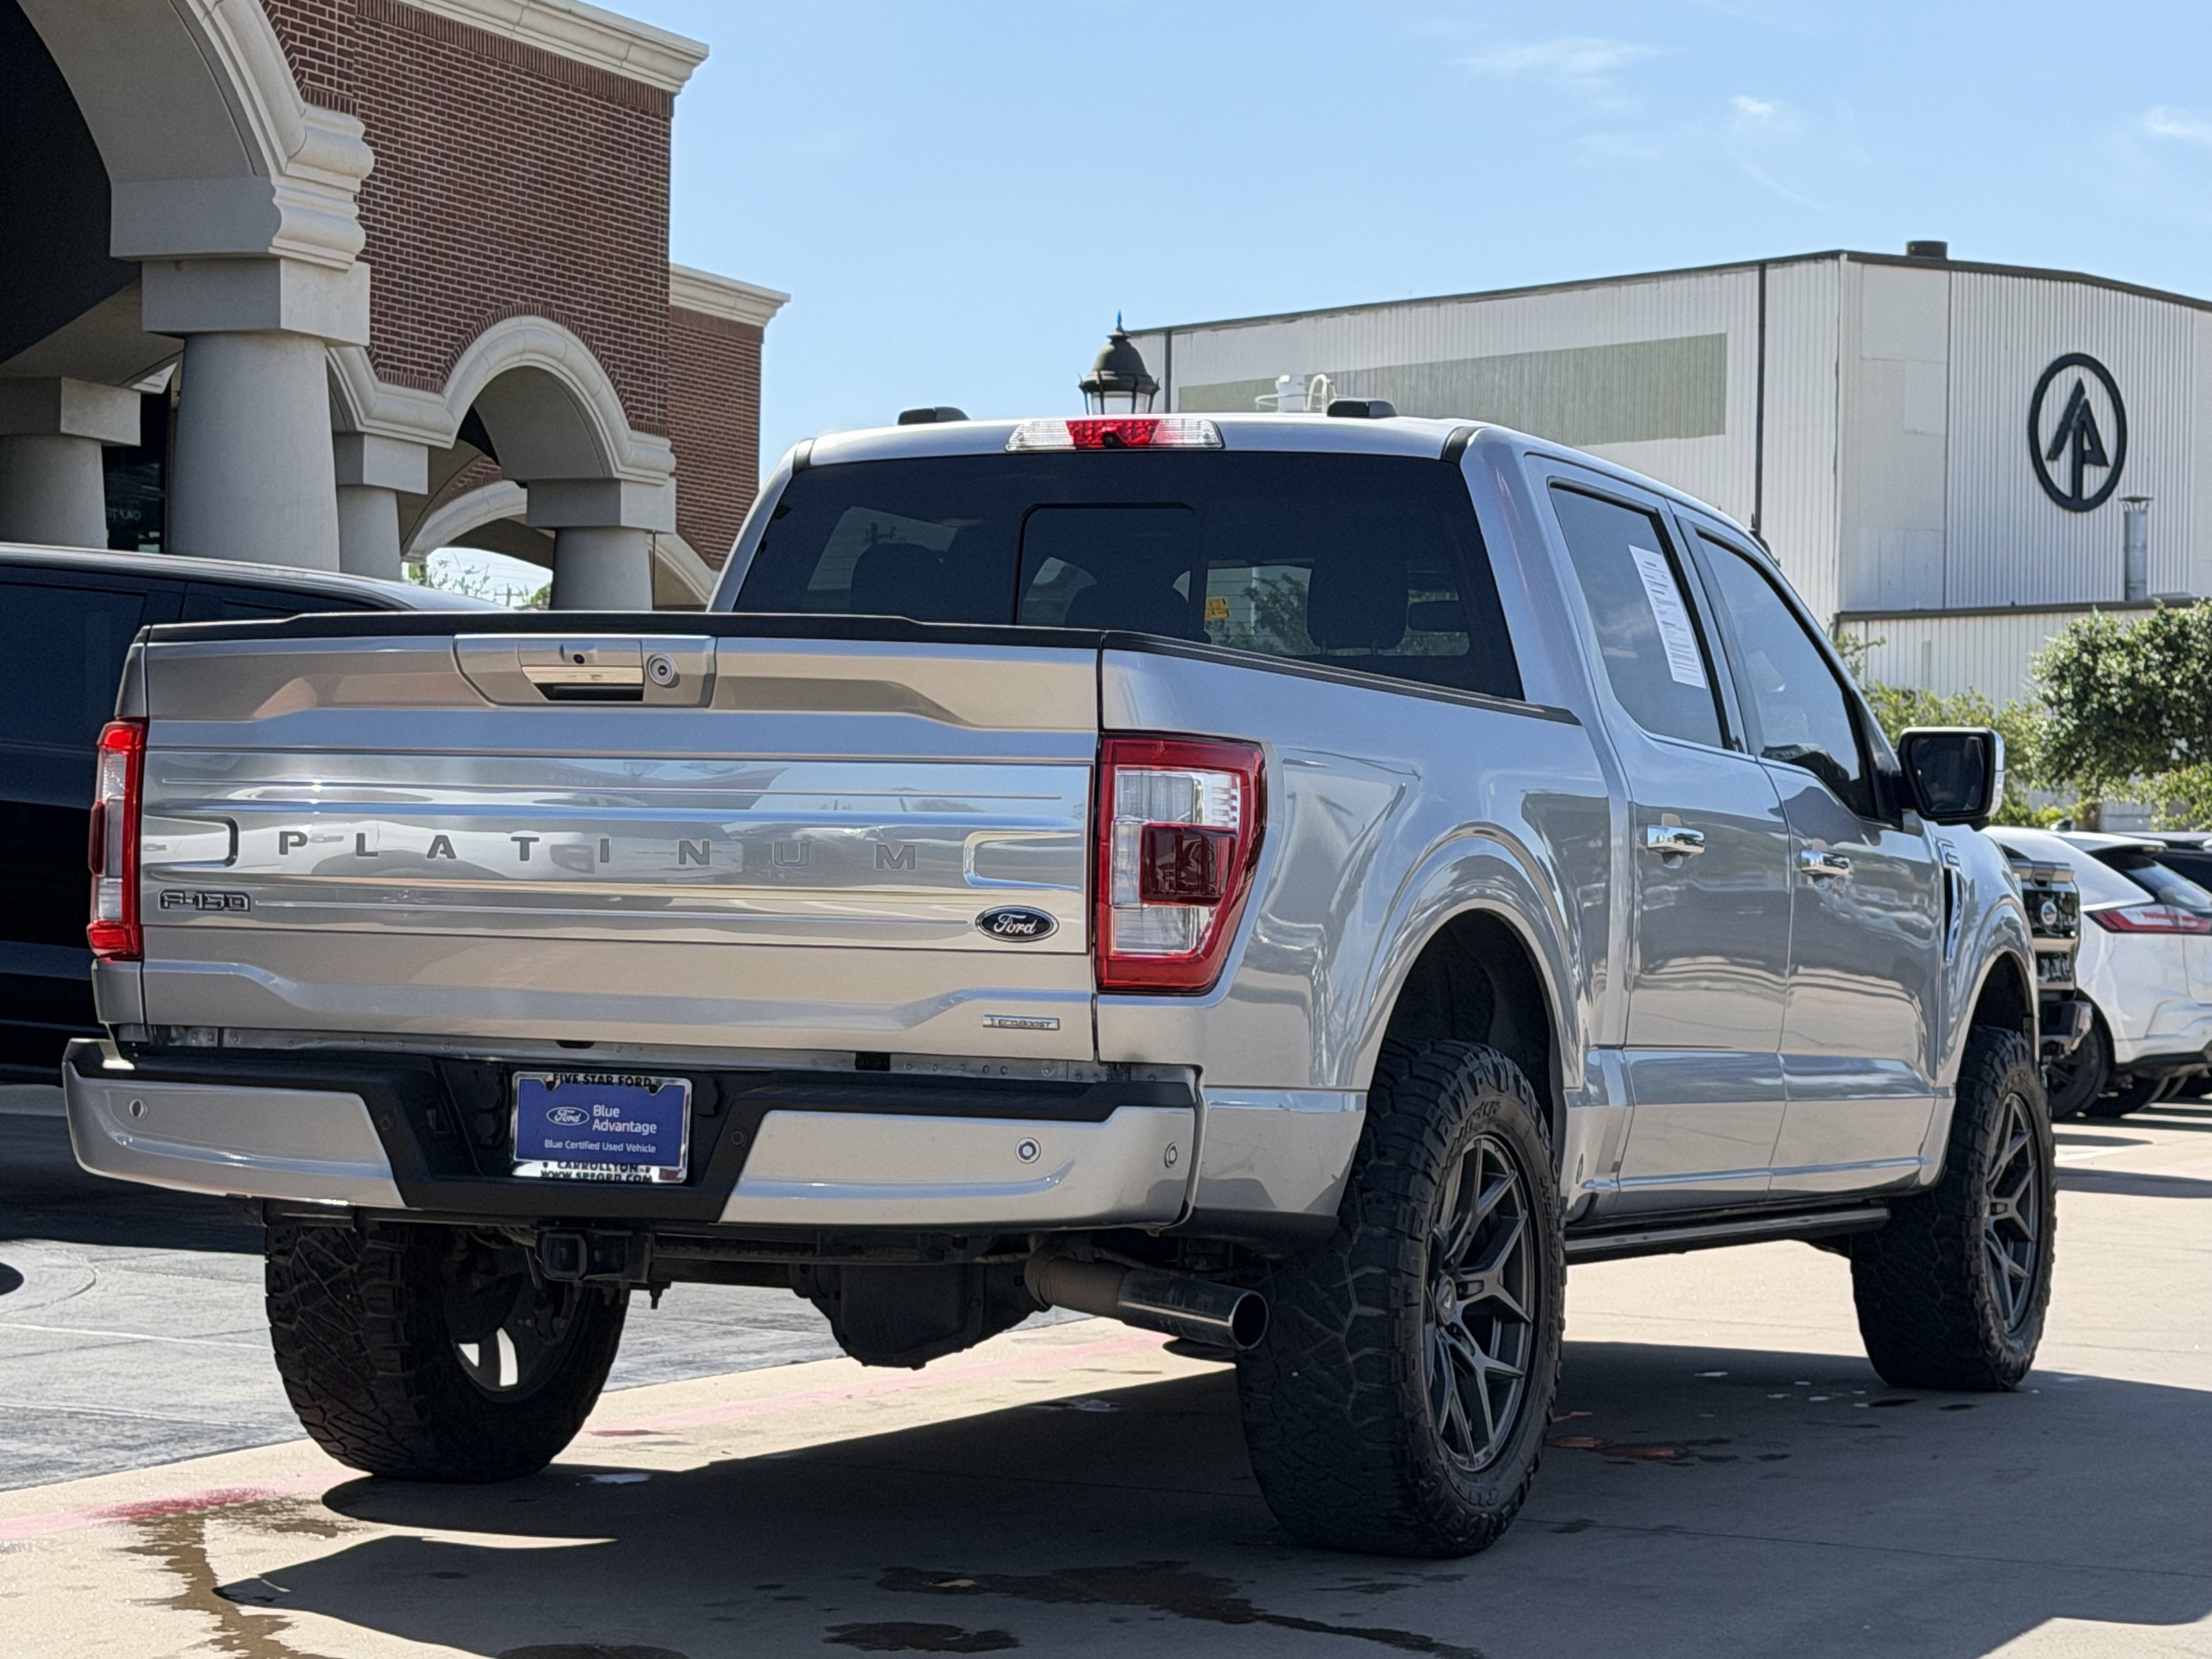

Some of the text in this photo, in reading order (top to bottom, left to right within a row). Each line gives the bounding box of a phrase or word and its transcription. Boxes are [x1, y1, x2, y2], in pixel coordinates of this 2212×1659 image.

[279, 831, 916, 870] PLATINUM
[159, 889, 251, 912] F-150
[994, 913, 1037, 934] Ford
[554, 1074, 652, 1087] FIVE STAR FORD
[554, 1109, 582, 1122] Ford
[593, 1104, 620, 1118] Blue
[592, 1119, 657, 1136] Advantage
[544, 1139, 656, 1153] Blue Certified Used Vehicle
